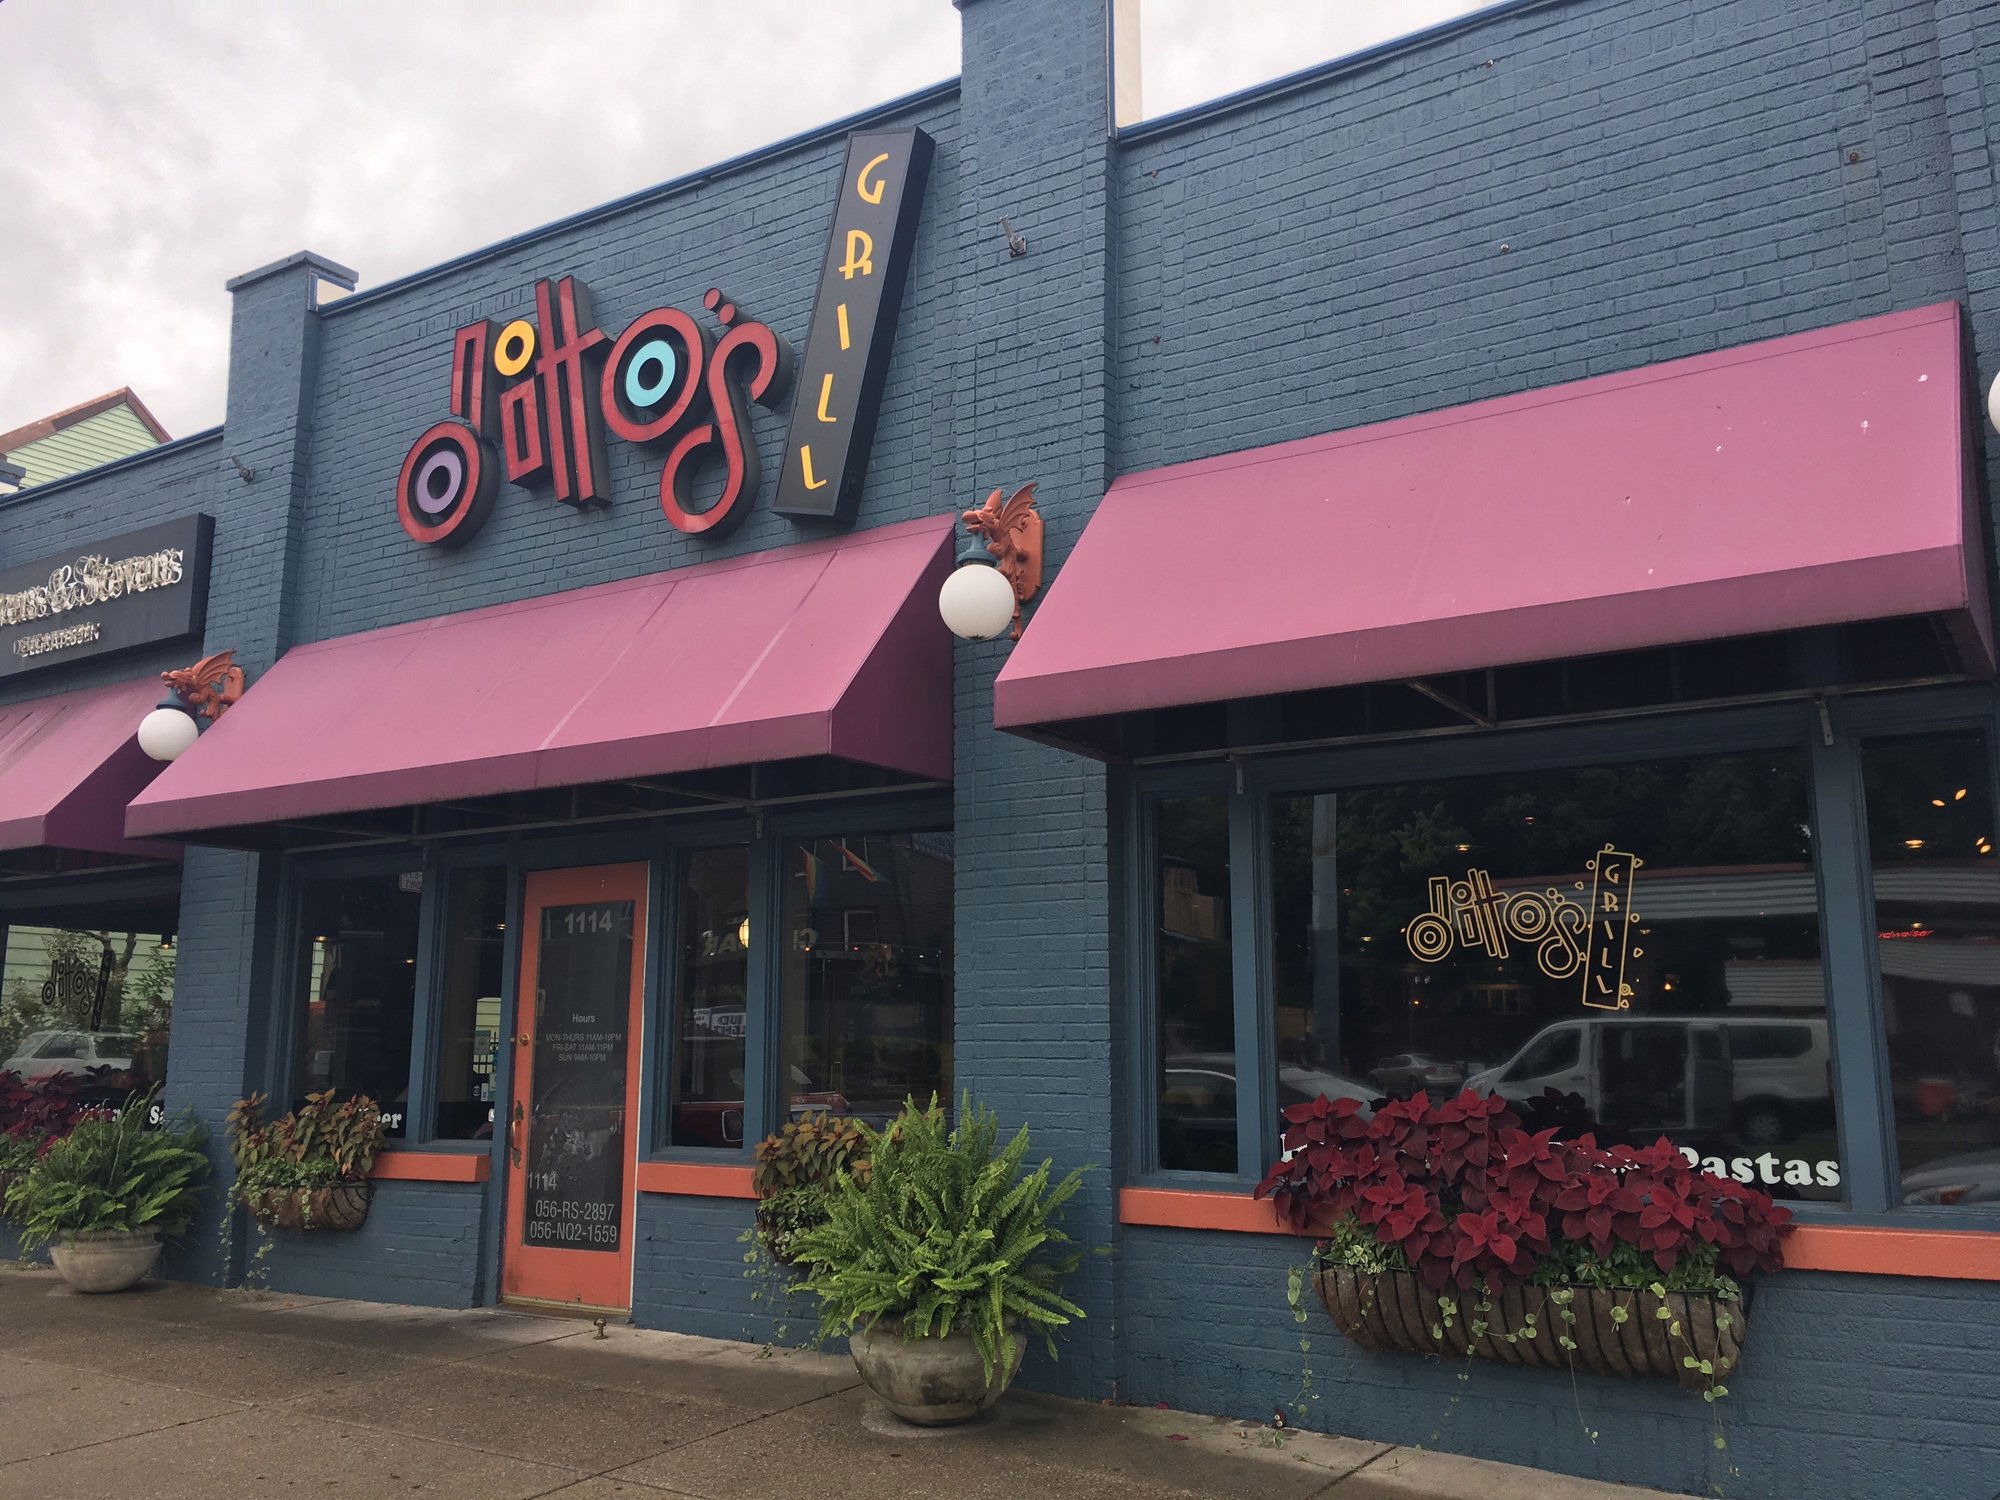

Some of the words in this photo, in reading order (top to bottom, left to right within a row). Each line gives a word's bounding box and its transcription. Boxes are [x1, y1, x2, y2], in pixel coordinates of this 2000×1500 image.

[798, 152, 890, 491] GRILL
[564, 909, 613, 934] 1114
[1595, 864, 1621, 994] GRILL
[1877, 929, 1934, 939] udweiser
[572, 1013, 595, 1023] Hours
[528, 1171, 557, 1191] 1114
[535, 1200, 615, 1221] 056-RS-2897
[530, 1221, 617, 1243] 056-NQ2-1559
